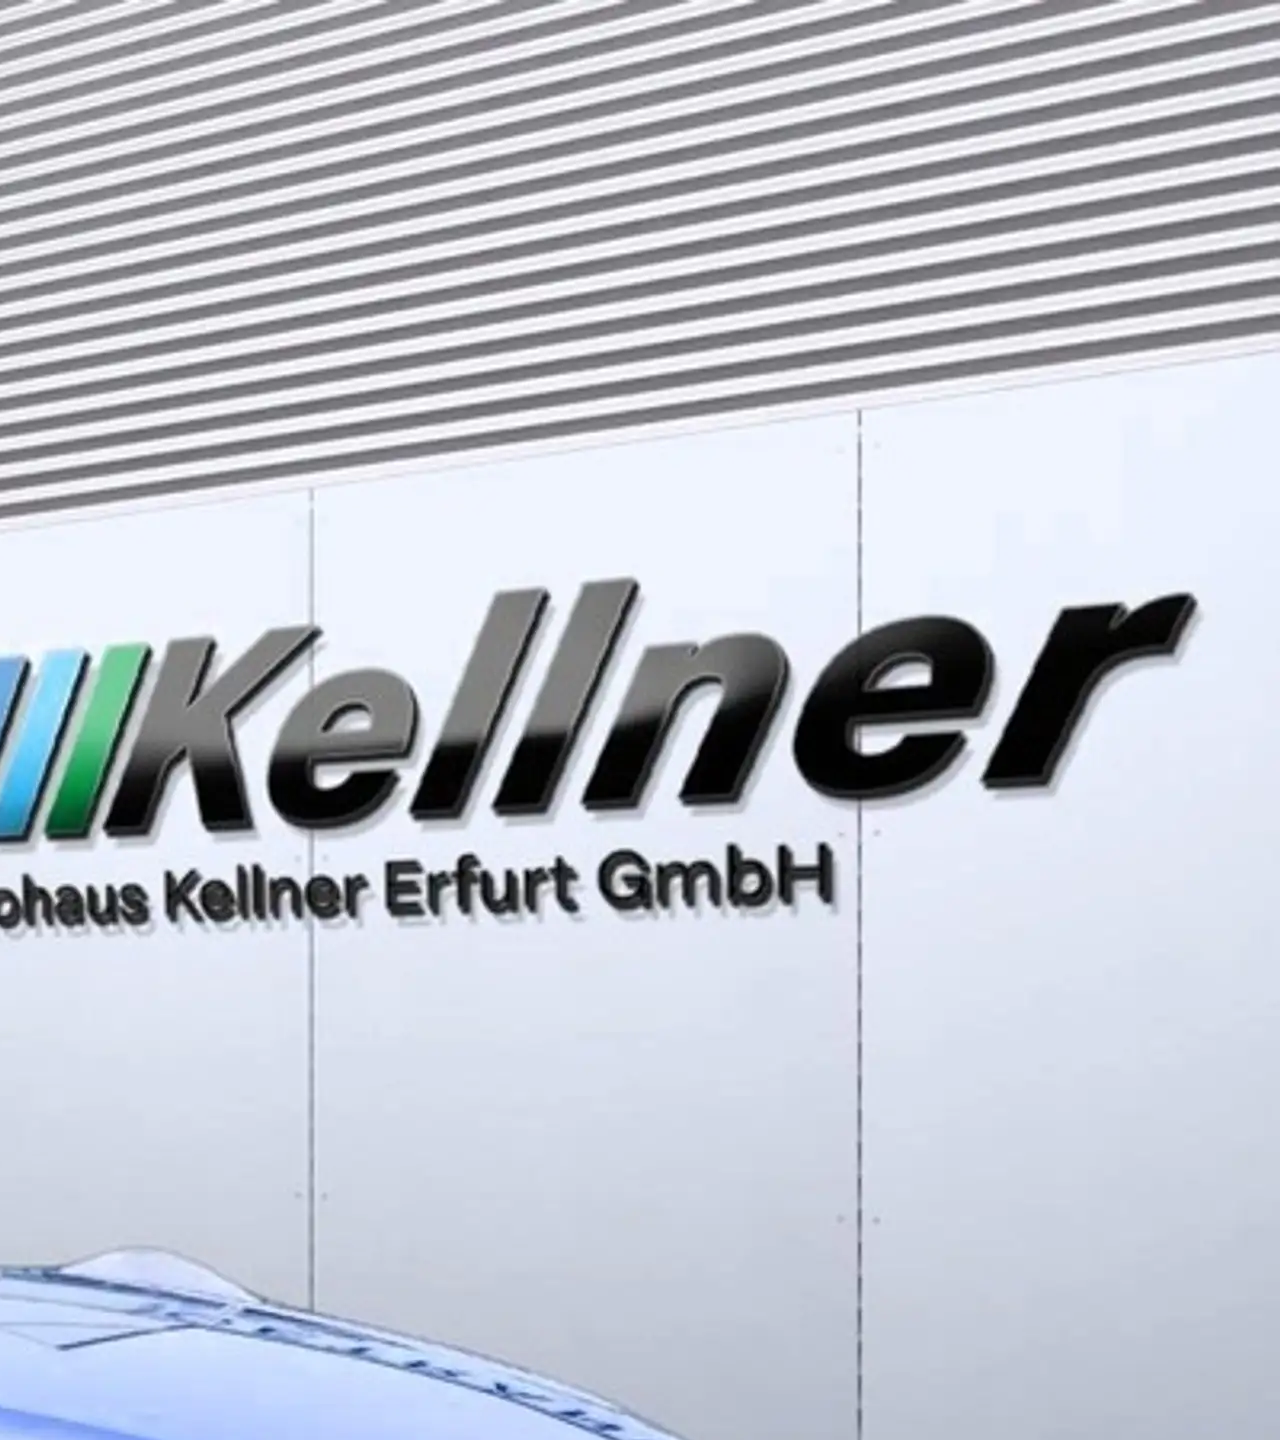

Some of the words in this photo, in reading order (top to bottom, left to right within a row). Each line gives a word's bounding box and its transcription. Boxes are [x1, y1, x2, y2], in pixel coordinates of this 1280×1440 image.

[104, 577, 1198, 838] Kellner
[164, 864, 369, 922] Kellner
[384, 852, 579, 916] Erfurt
[598, 842, 833, 911] GmbH
